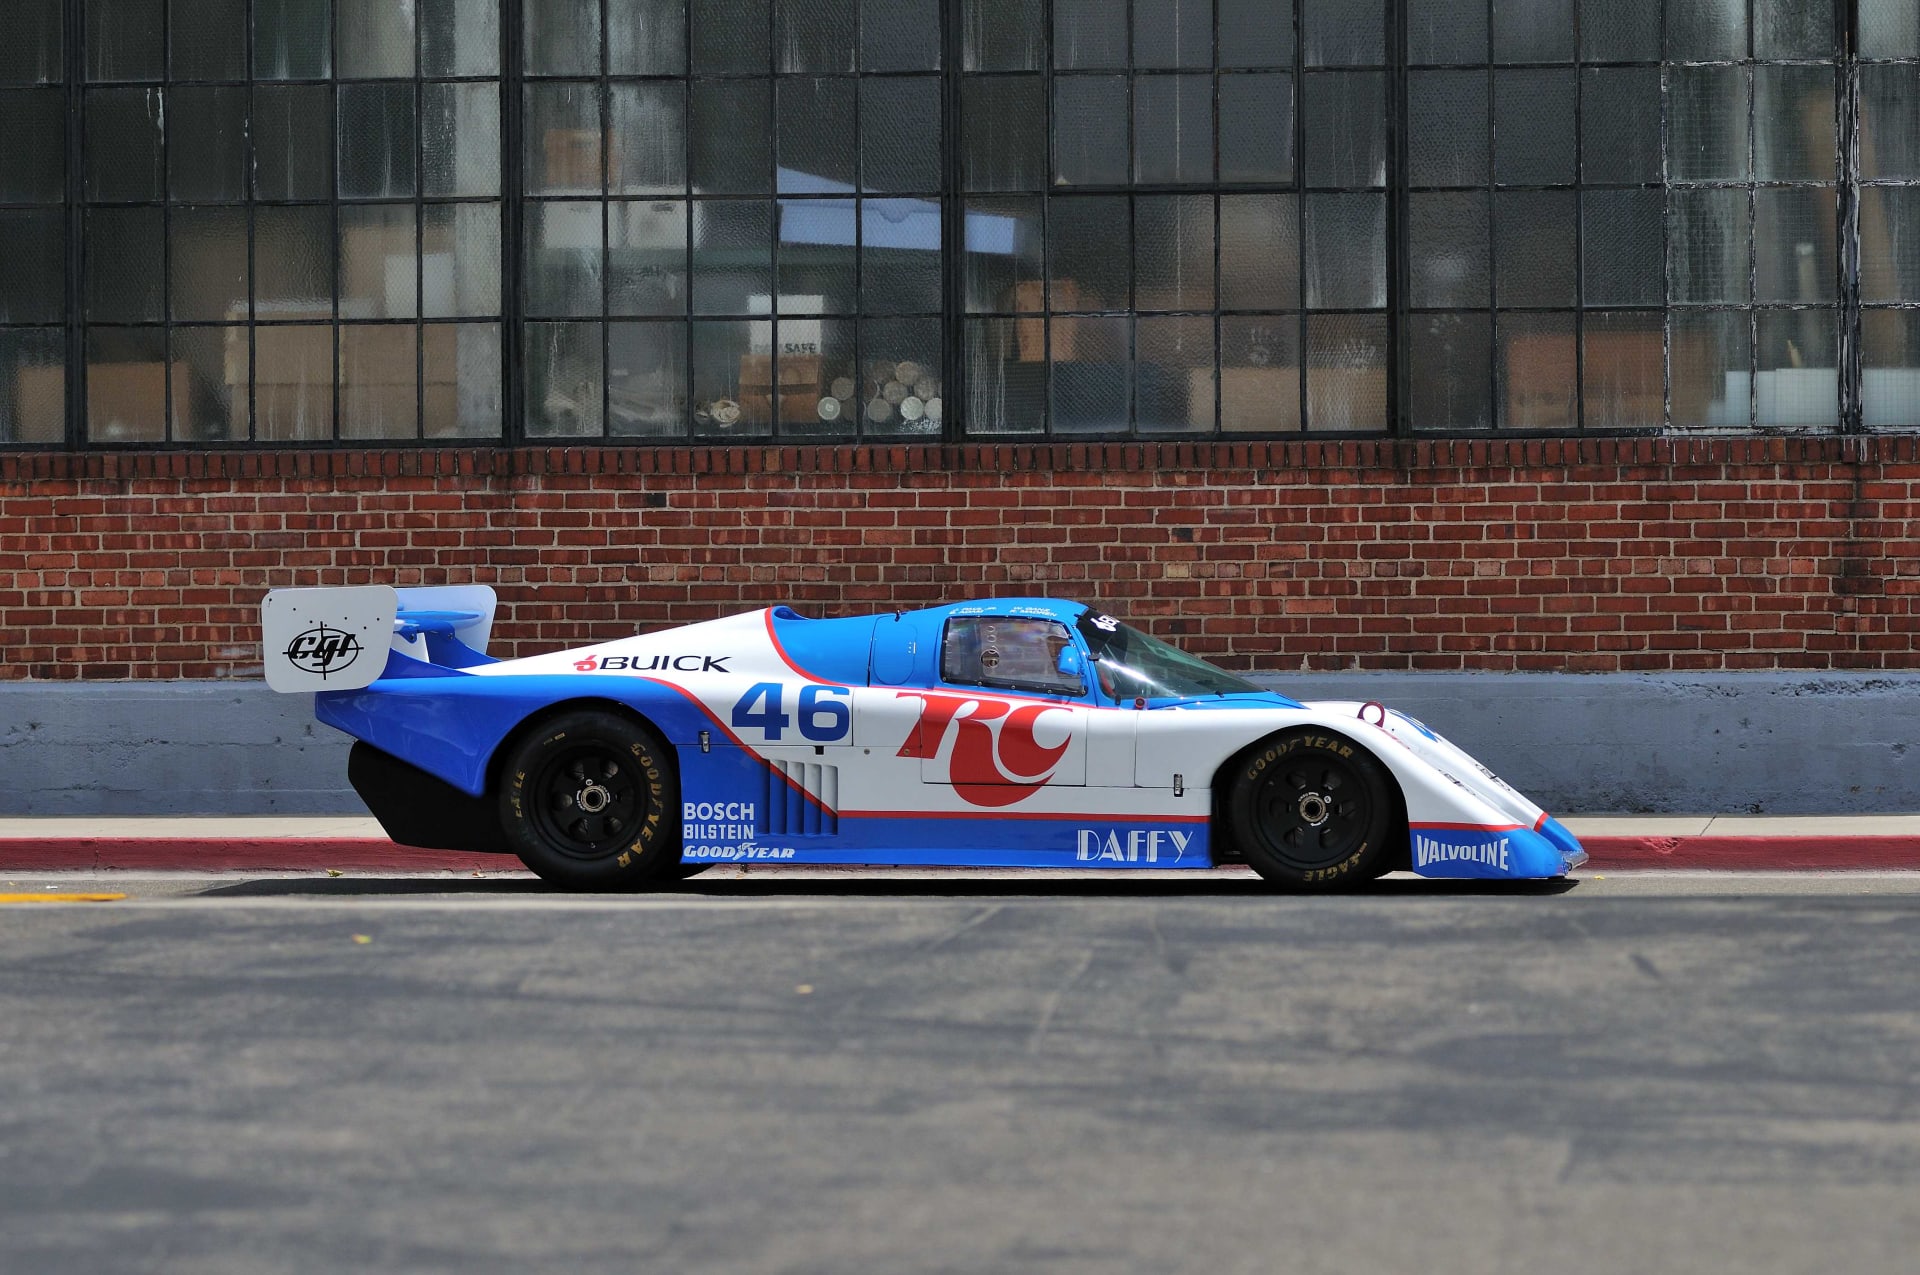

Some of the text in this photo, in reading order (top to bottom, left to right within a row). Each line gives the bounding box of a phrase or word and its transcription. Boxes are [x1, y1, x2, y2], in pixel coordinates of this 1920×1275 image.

[599, 655, 732, 674] BUICK
[731, 682, 850, 742] 46
[895, 692, 1073, 808] RC
[683, 802, 755, 821] BOSCH
[683, 823, 754, 840] BILSTEIN
[1076, 828, 1194, 864] DAFFY
[1416, 834, 1509, 872] VALVOLINE
